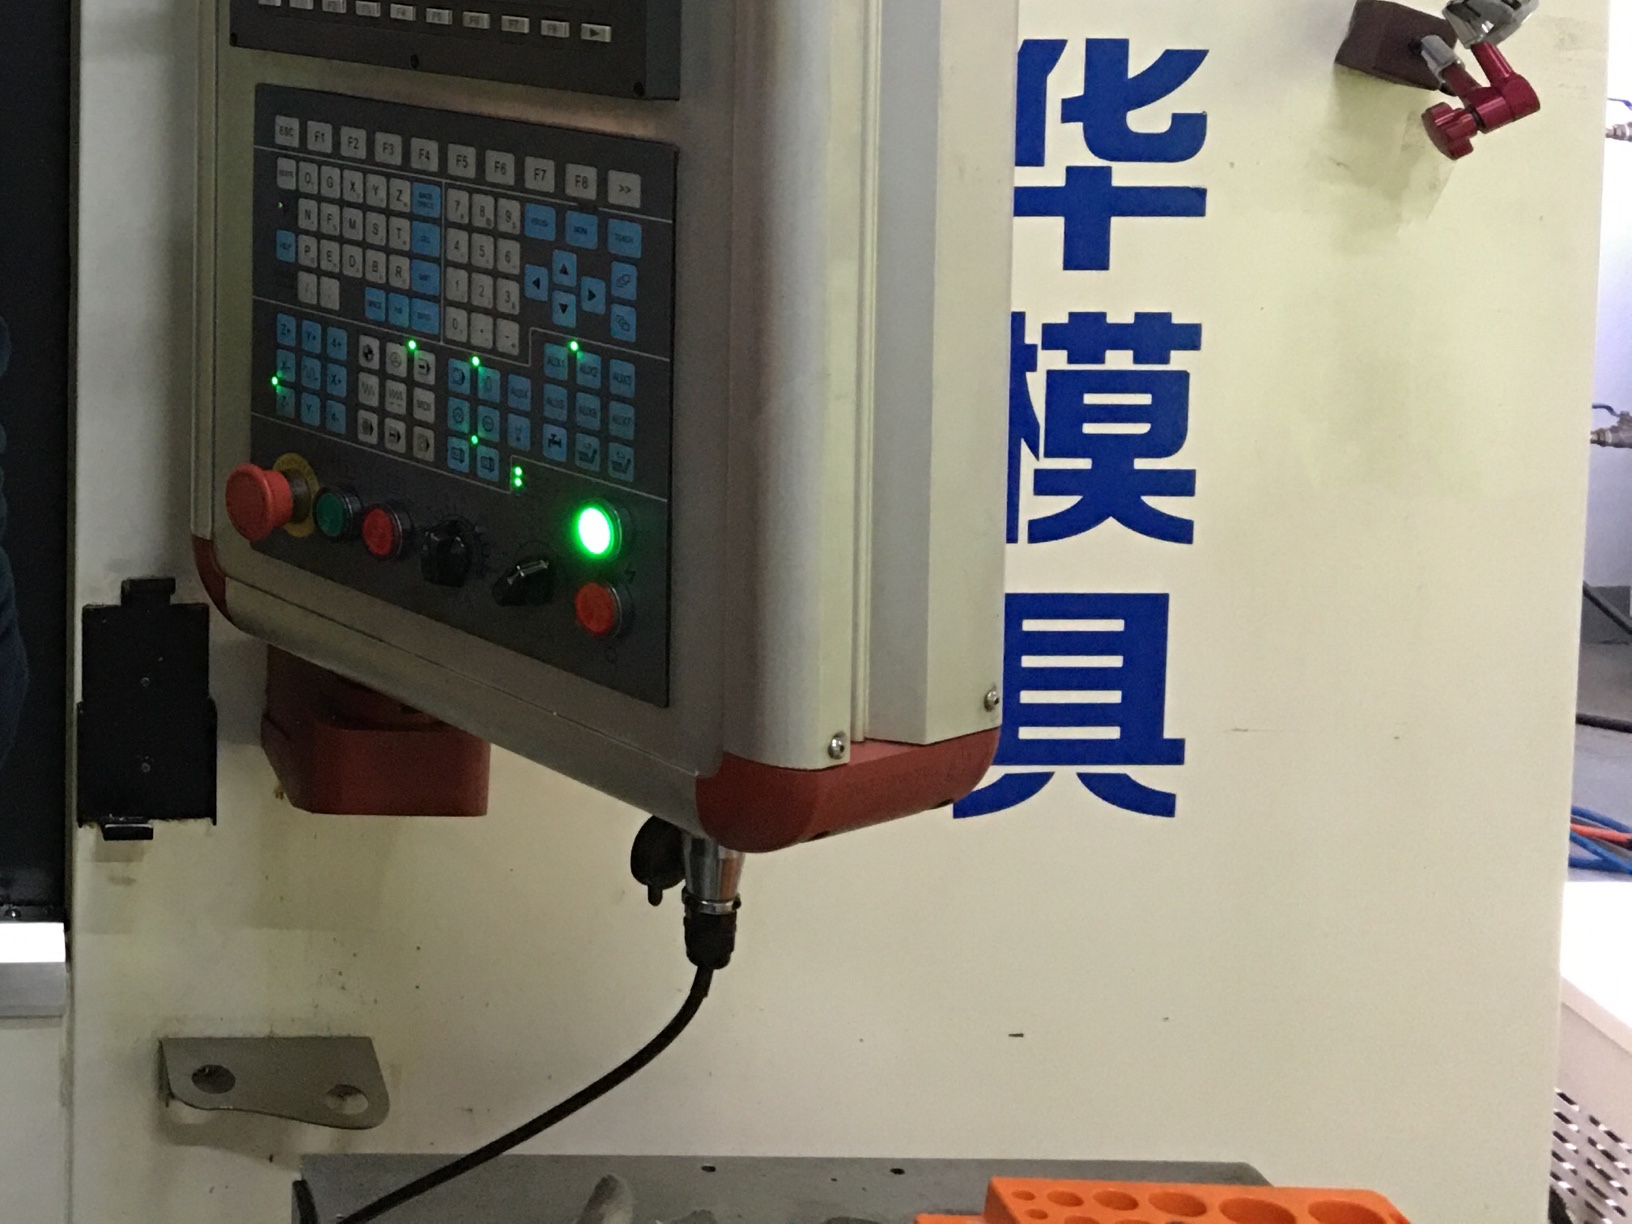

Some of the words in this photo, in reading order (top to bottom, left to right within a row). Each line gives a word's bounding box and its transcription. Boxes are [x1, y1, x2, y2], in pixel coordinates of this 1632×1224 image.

[314, 130, 325, 144] F1
[348, 136, 359, 150] F2
[382, 142, 395, 156] F3
[419, 147, 431, 161] F4
[456, 154, 468, 168] F5
[494, 161, 507, 175] F6
[534, 168, 546, 182] F7
[327, 176, 333, 188] G
[349, 180, 356, 193] X
[575, 174, 589, 189] F8
[372, 185, 379, 196] Y
[397, 189, 403, 202] Z
[454, 200, 460, 212] 7
[480, 205, 485, 218] 8
[305, 209, 311, 221] N
[326, 214, 332, 226] F
[505, 210, 511, 222] 9
[349, 218, 357, 230] M
[372, 223, 379, 235] S
[396, 227, 402, 239] T
[304, 245, 311, 257] P
[454, 240, 459, 251] 4
[479, 245, 485, 258] 5
[326, 250, 332, 262] E
[505, 250, 511, 263] 6
[372, 260, 378, 272] B
[395, 265, 402, 278] R
[479, 285, 485, 298] 2
[505, 291, 511, 303] 3
[280, 323, 291, 335] Z+
[306, 330, 316, 342] Y+
[331, 374, 342, 386] X+
